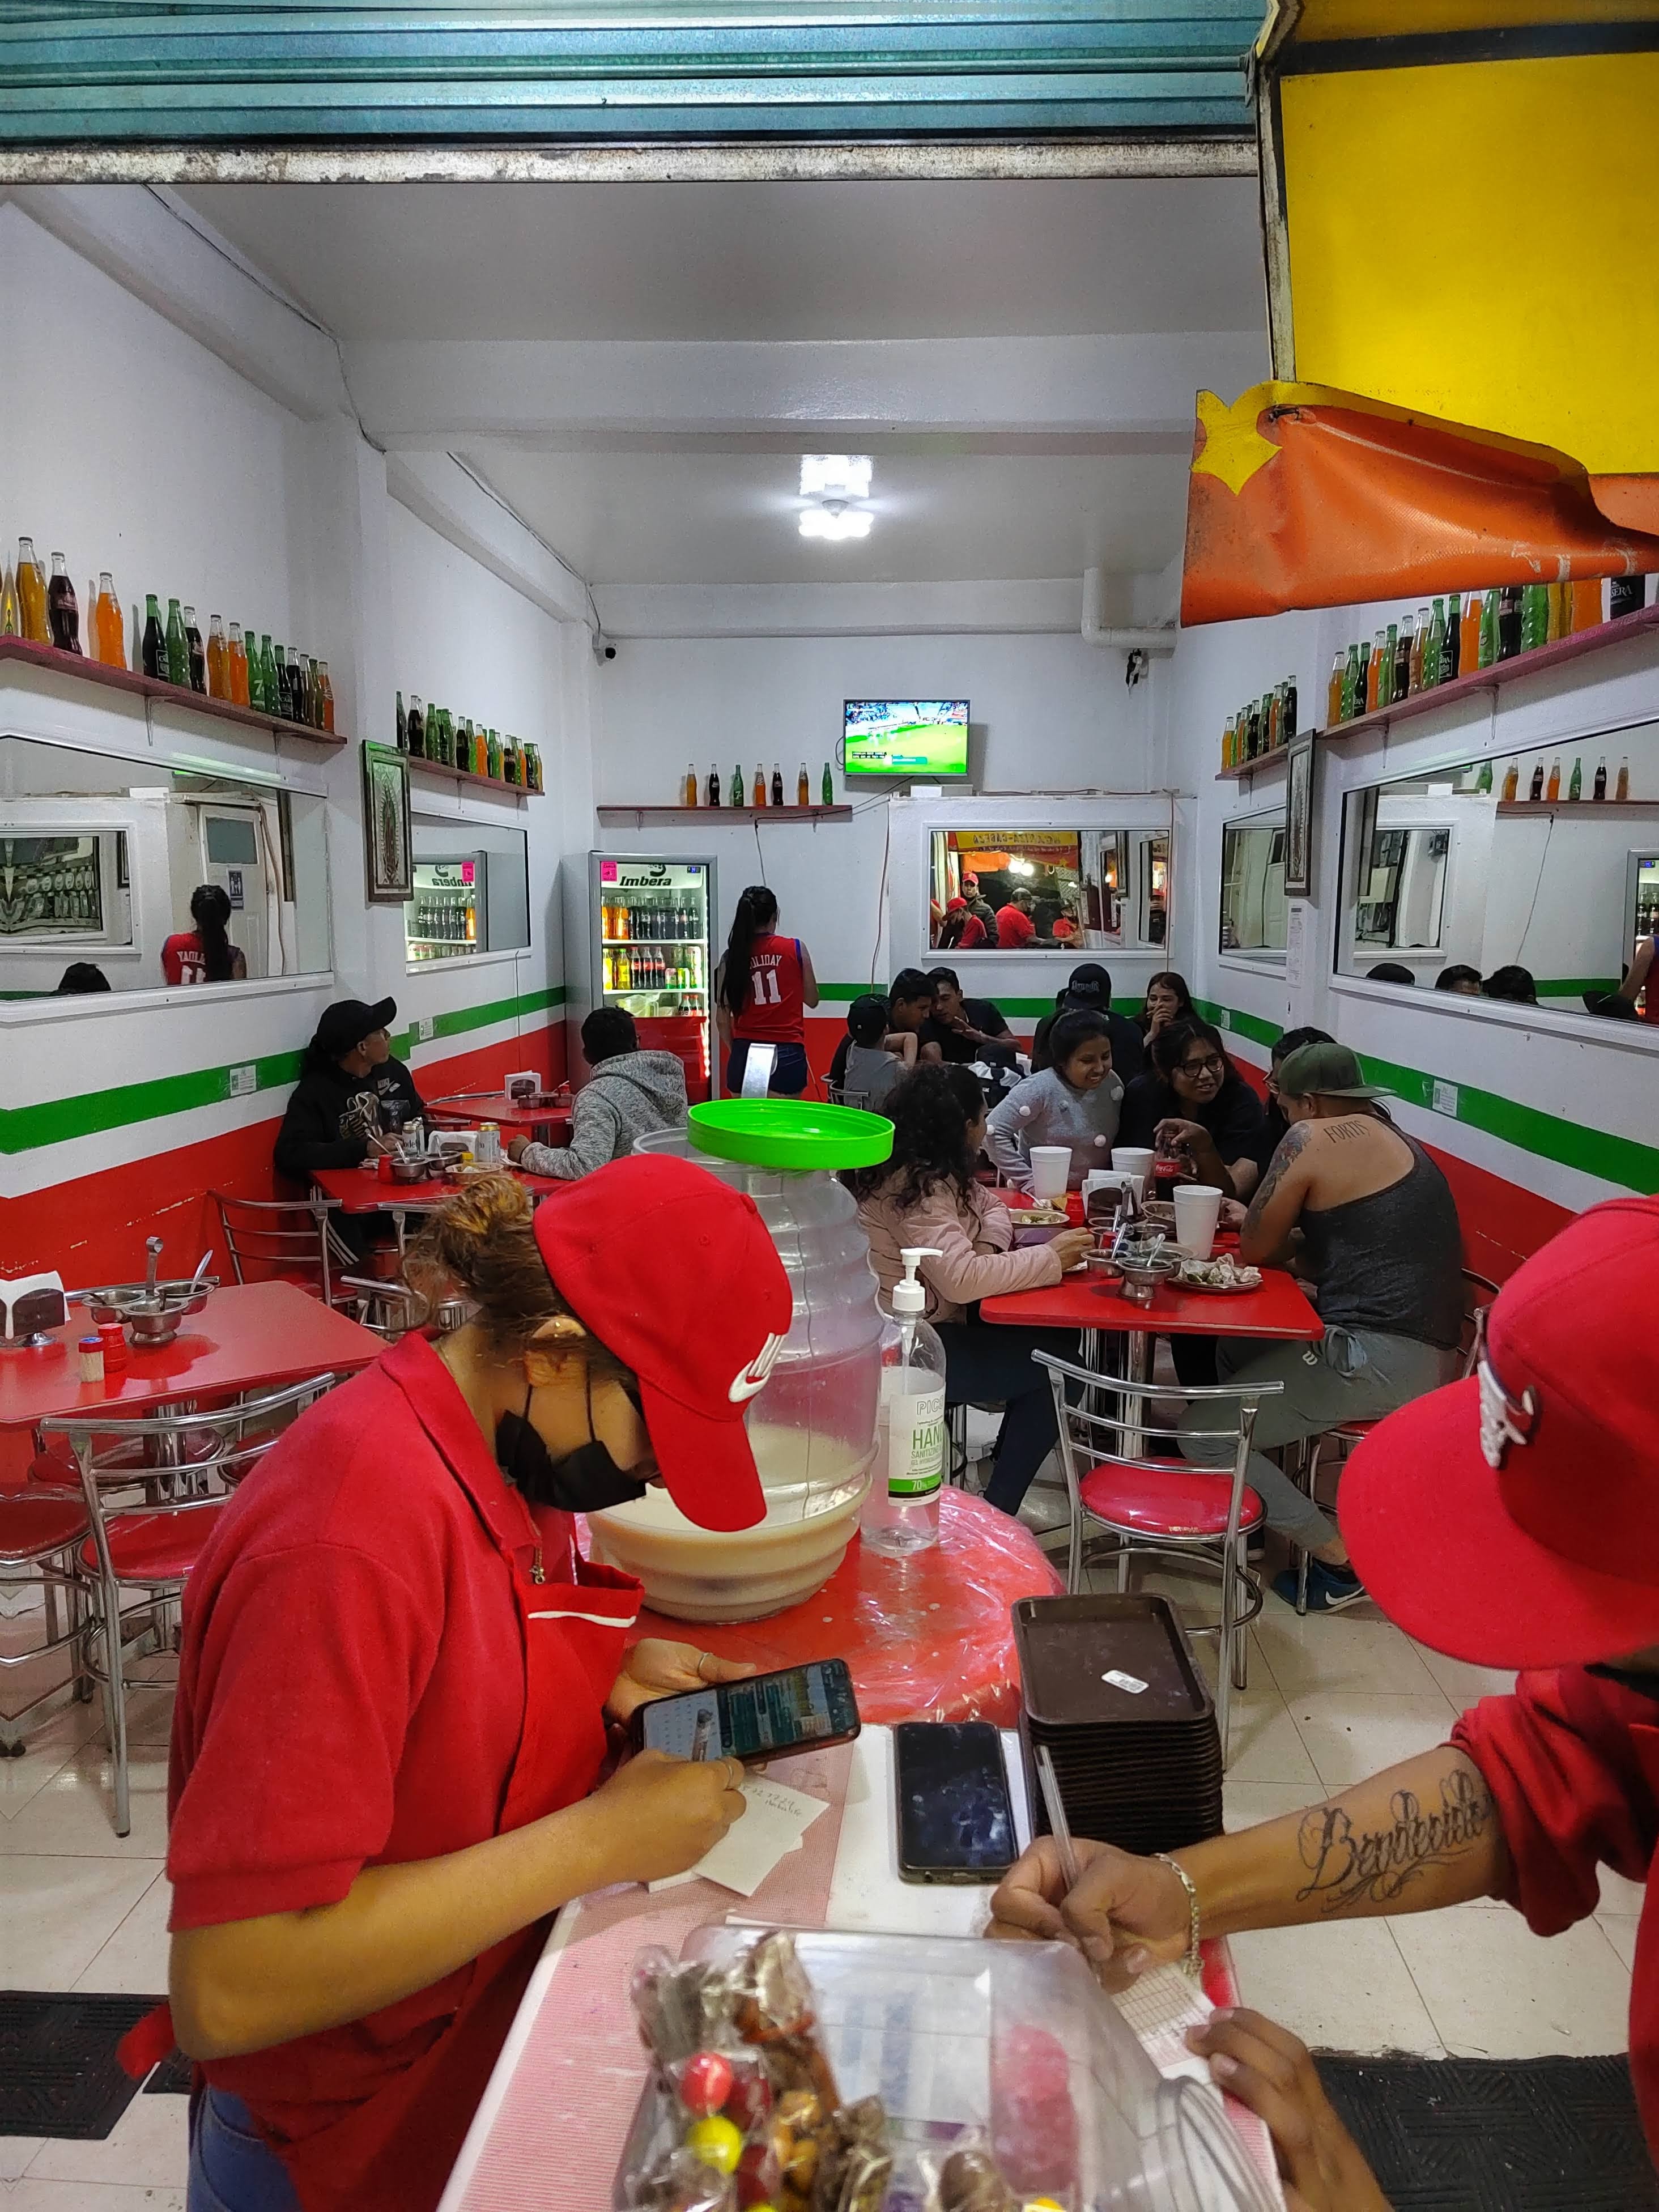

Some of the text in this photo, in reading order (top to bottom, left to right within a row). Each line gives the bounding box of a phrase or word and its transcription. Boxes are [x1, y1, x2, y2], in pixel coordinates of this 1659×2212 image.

[619, 876, 672, 887] Imbera
[749, 954, 782, 969] OLIDAY
[751, 969, 781, 1005] 11
[1323, 1120, 1371, 1143] FORTIS
